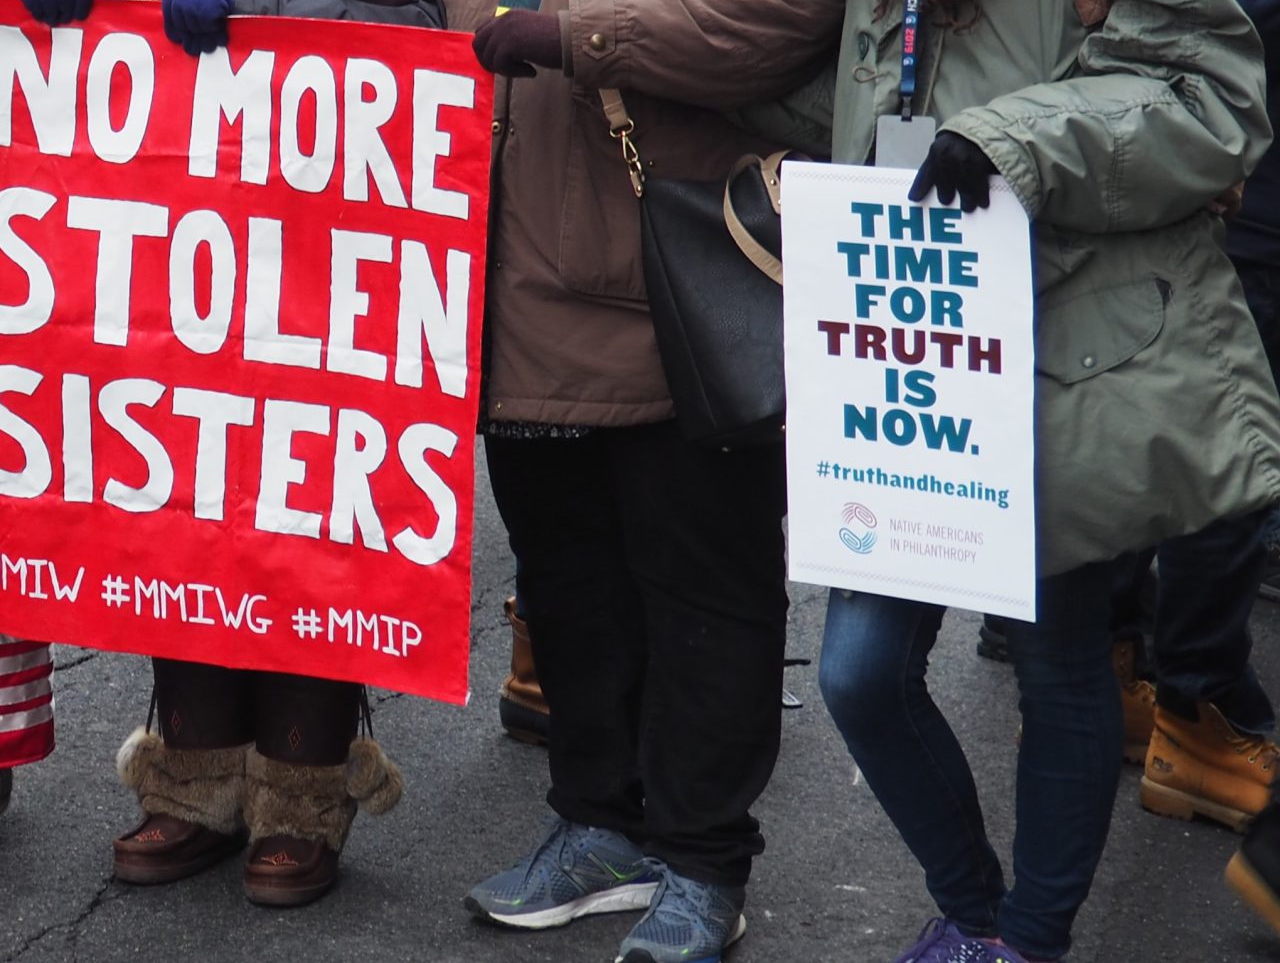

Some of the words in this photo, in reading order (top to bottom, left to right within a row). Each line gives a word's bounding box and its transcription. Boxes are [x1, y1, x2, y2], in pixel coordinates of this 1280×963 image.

[904, 27, 915, 54] 2019
[187, 45, 475, 220] MORE
[851, 201, 963, 245] THE
[837, 241, 979, 288] TIME
[855, 283, 964, 328] FOR
[817, 319, 1002, 375] TRUTH
[885, 368, 937, 408] IS
[843, 403, 980, 456] NOW.
[816, 460, 1010, 509] #truthandhealing
[889, 518, 923, 537] NATIVE
[926, 522, 984, 546] AMERICANS
[890, 537, 900, 551] IN
[903, 540, 977, 565] PHILANTHROPY
[101, 573, 273, 635] #MMIWG
[291, 607, 423, 657] #MMIP
